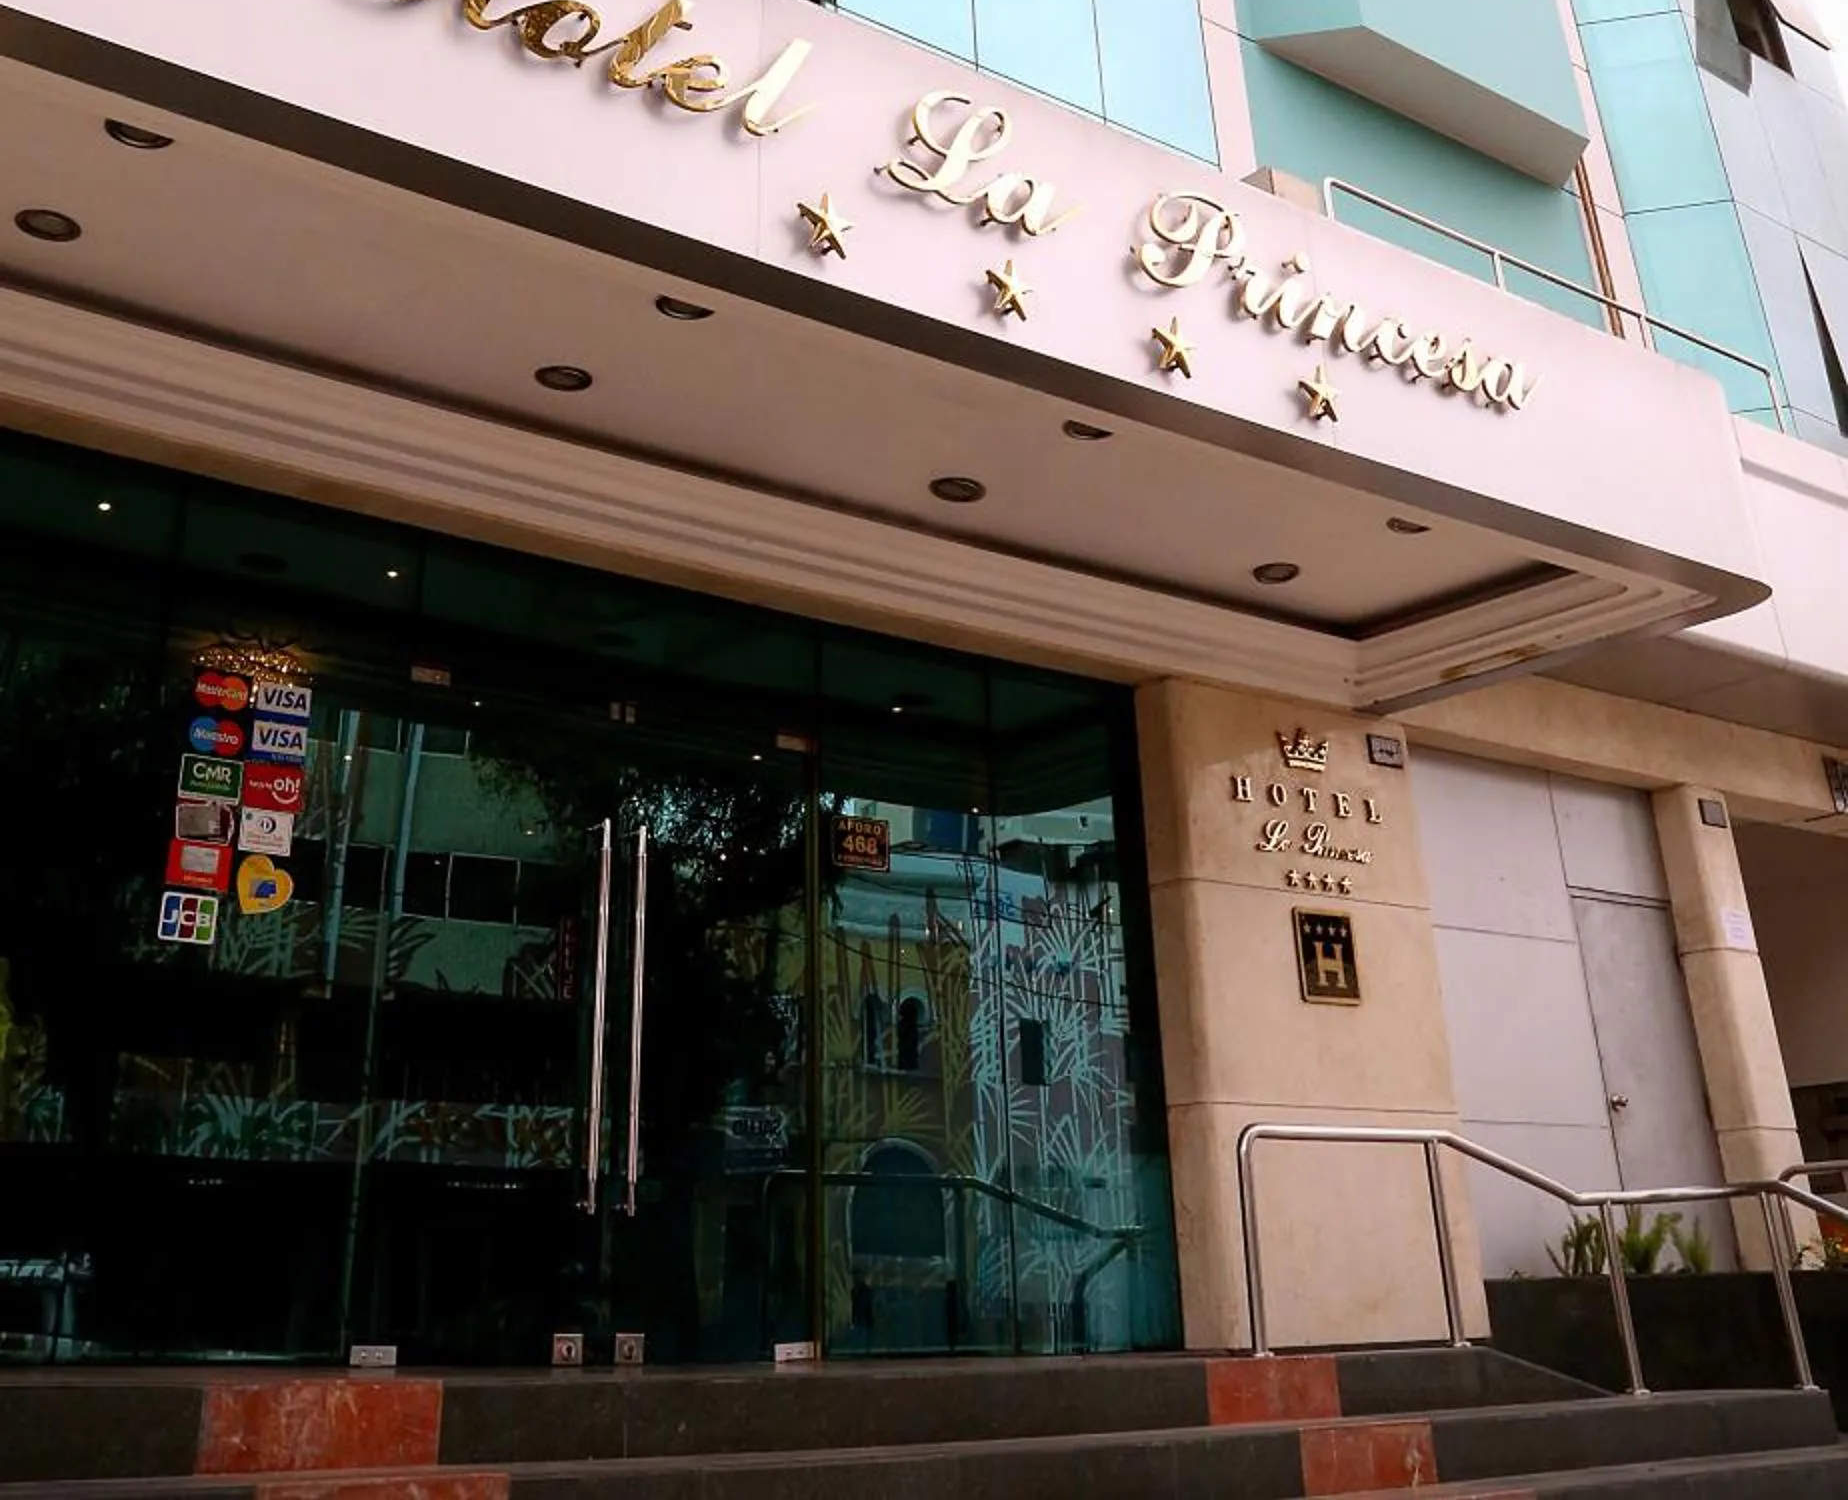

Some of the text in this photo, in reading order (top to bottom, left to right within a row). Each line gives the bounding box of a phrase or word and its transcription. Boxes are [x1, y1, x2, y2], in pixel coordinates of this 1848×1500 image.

[884, 89, 1081, 236] La
[1133, 191, 1543, 411] Princesa
[263, 688, 307, 710] VISA
[193, 728, 239, 745] Maestro
[259, 727, 303, 750] VISA
[193, 762, 231, 784] CMR
[1233, 776, 1383, 824] HOTEL
[841, 835, 879, 855] 468
[163, 909, 212, 926] JCB
[1312, 940, 1349, 989] H
